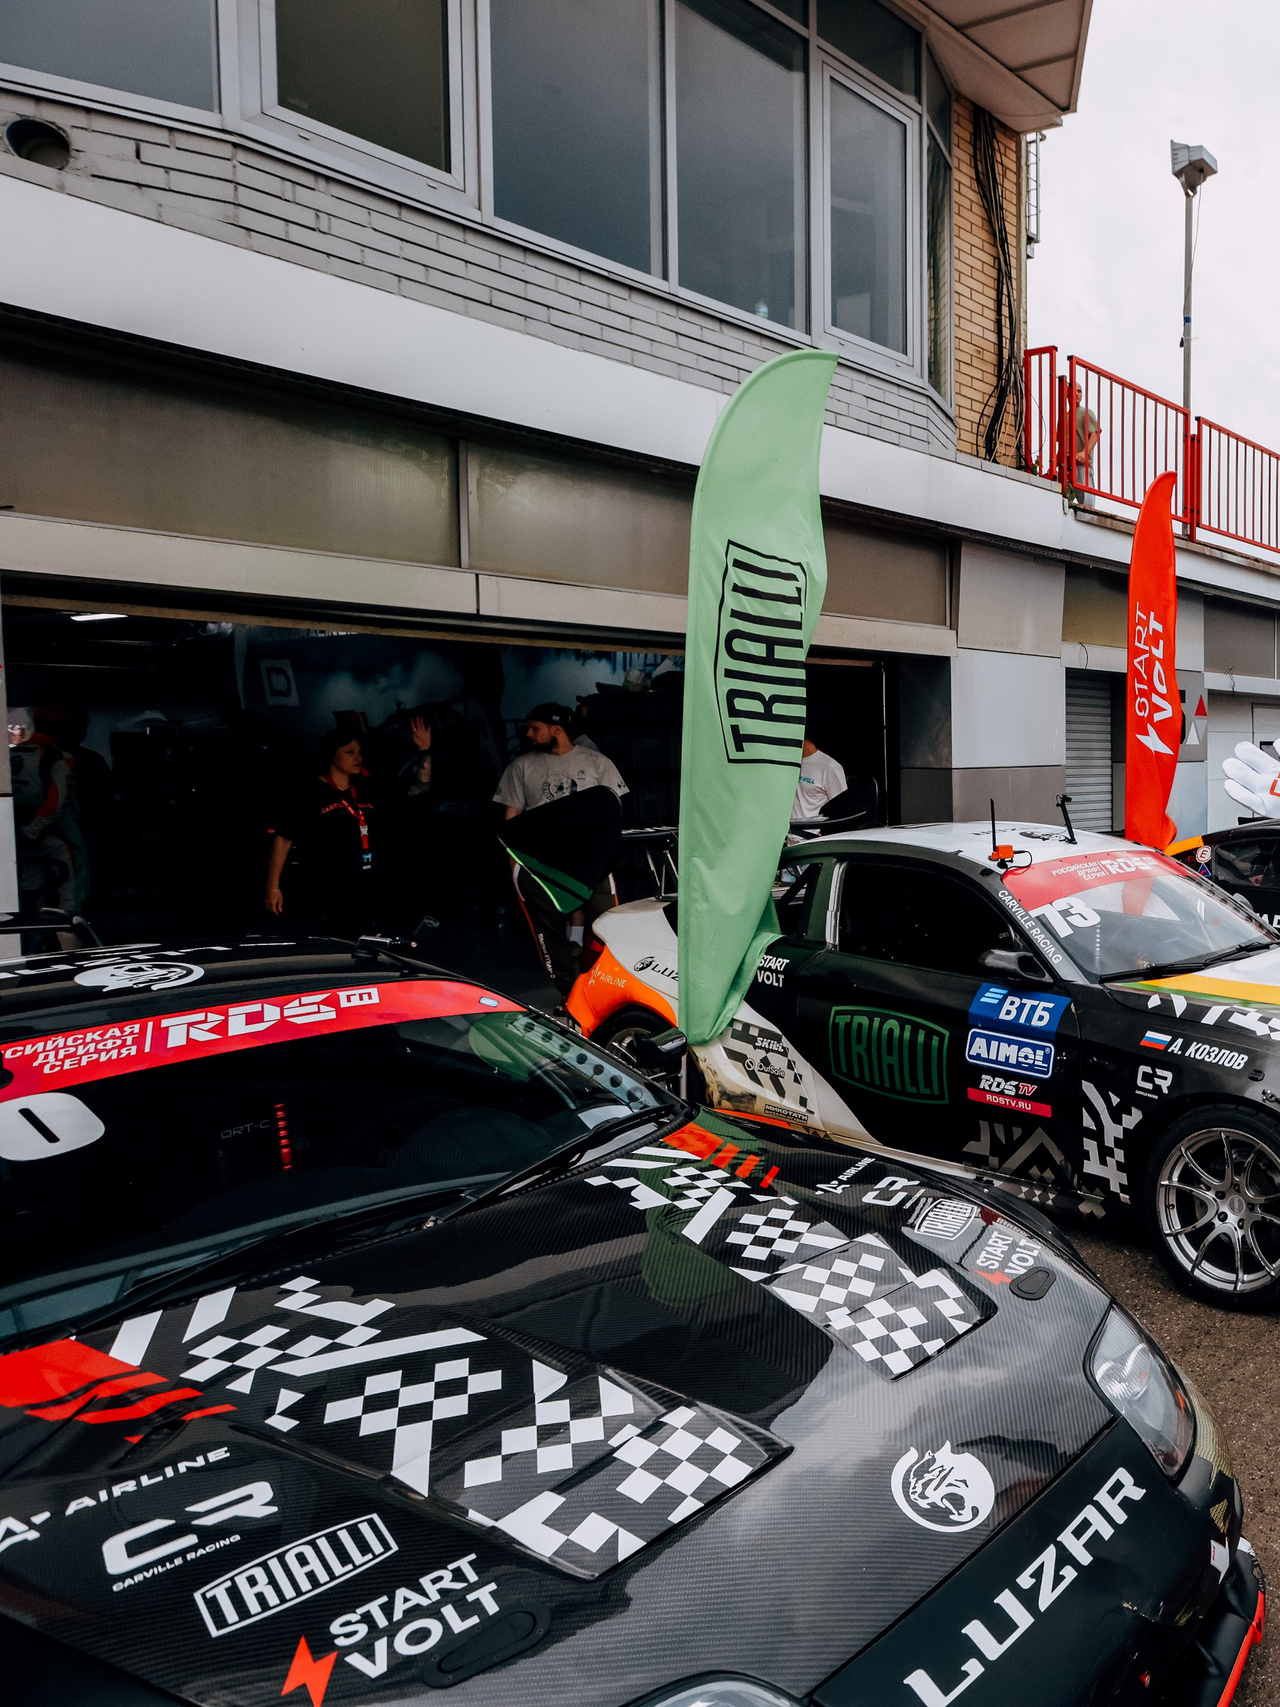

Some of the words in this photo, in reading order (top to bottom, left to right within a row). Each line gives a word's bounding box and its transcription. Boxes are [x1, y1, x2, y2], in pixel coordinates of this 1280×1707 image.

[724, 557, 807, 753] TRIALLI
[1134, 600, 1150, 718] START
[1148, 610, 1174, 724] VOLT
[1051, 861, 1099, 877] РОССИЙСКАЯ
[1077, 866, 1101, 877] ДРИФТ
[1082, 871, 1108, 881] СЕРИЯ
[1100, 857, 1152, 875] RDS
[998, 889, 1036, 929] CARVILLE
[1030, 927, 1063, 965] RACING
[651, 963, 679, 982] LUZ
[757, 970, 785, 988] VOLT
[758, 954, 790, 971] START
[600, 973, 628, 989] AIRLINE
[161, 992, 337, 1049] RDS
[998, 995, 1056, 1027] ВТБ
[0, 1023, 141, 1060] СИЙСКАЯ
[32, 1033, 139, 1068] ДРИФТ
[42, 1044, 138, 1075] СЕРИЯ
[835, 1014, 940, 1096] TRIALLI
[968, 1036, 1049, 1072] AIMOL
[1167, 1038, 1182, 1055] А.
[1184, 1041, 1249, 1070] КОЗЛОВ
[1136, 1064, 1173, 1095] CR
[985, 1093, 1032, 1111] RDSTV.RU
[220, 1119, 271, 1140] QRT-C
[838, 1156, 876, 1181] AIRLINE
[861, 1176, 920, 1207] CR
[919, 1199, 973, 1237] TRIALLI
[976, 1230, 1014, 1270] START
[1004, 1238, 1042, 1275] VOLT
[64, 1446, 232, 1517] AIRLINE
[101, 1480, 280, 1576] CR
[112, 1555, 184, 1593] CARVILLE
[186, 1533, 241, 1560] RACING
[204, 1519, 386, 1628] TRIALLI
[328, 1552, 480, 1648] START
[902, 1466, 1147, 1707] LUZAR
[343, 1581, 501, 1680] VOLT
